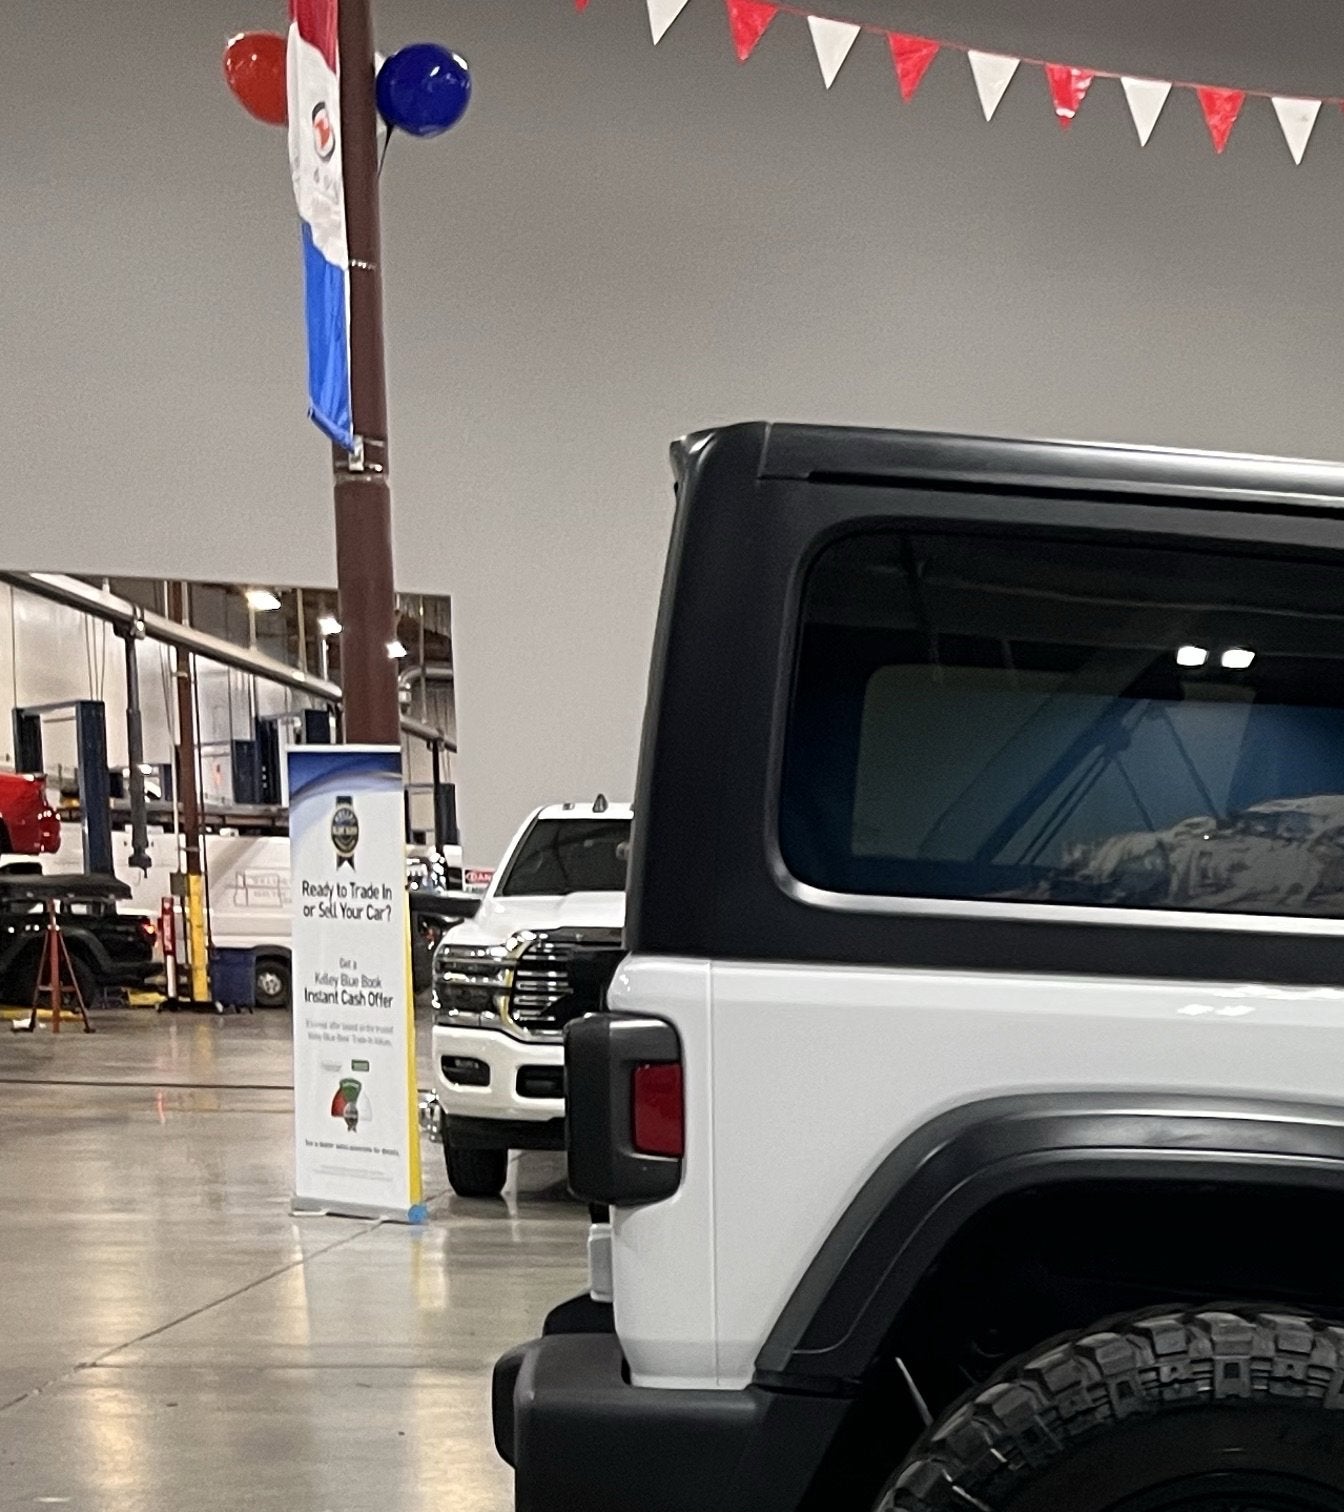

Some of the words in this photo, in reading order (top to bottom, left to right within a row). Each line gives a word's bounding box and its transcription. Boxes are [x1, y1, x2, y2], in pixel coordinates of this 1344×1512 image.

[302, 879, 334, 904] Ready
[336, 882, 348, 898] to
[349, 882, 380, 899] Trade
[382, 883, 393, 900] In
[303, 904, 316, 917] or
[318, 901, 338, 919] Sell
[340, 902, 364, 919] Your
[366, 903, 392, 922] Car?
[304, 986, 339, 1004] Instant
[341, 989, 366, 1006] Cash
[367, 990, 394, 1008] Offer
